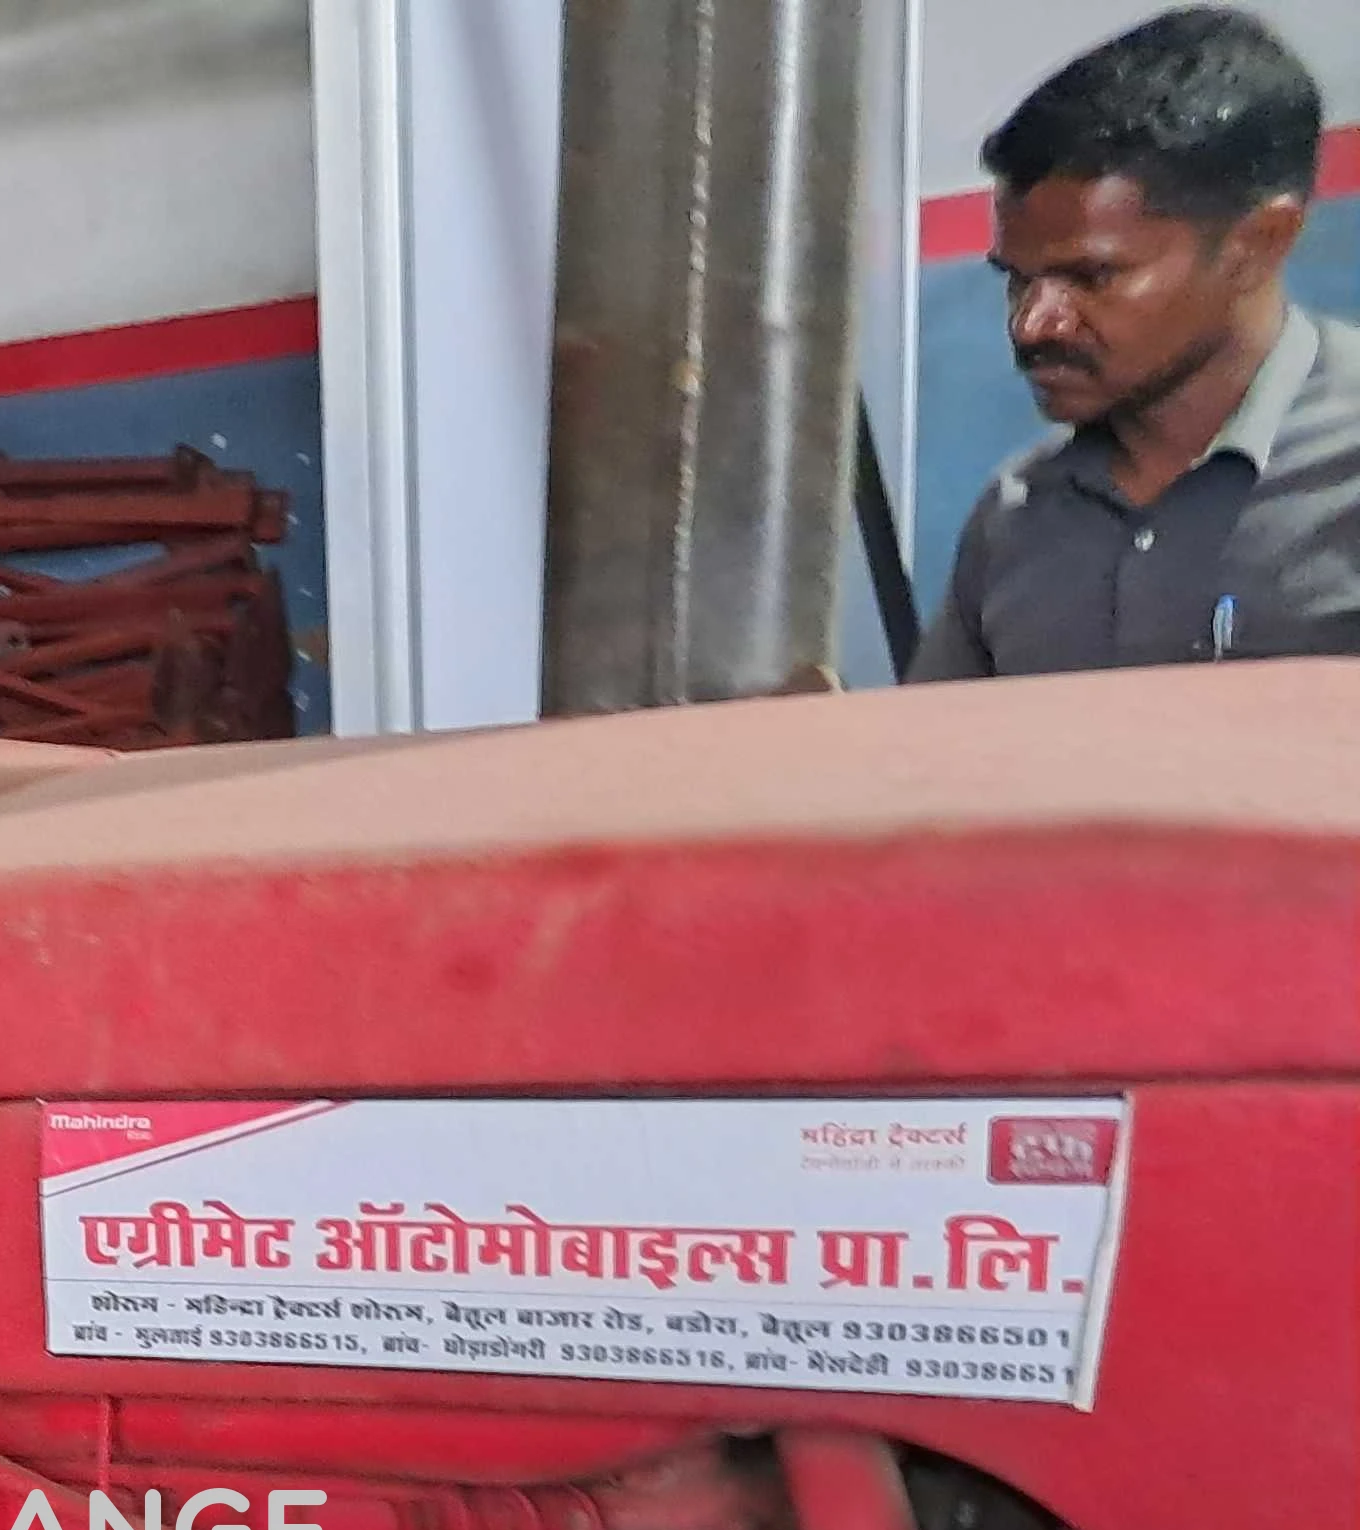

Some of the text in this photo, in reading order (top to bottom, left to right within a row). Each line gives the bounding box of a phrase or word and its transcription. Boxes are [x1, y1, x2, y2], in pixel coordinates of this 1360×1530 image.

[79, 1201, 296, 1270] एग्रीमेट
[315, 1202, 796, 1290] ऑटोमोबाइल्स
[841, 1320, 1072, 1349] 9303866501
